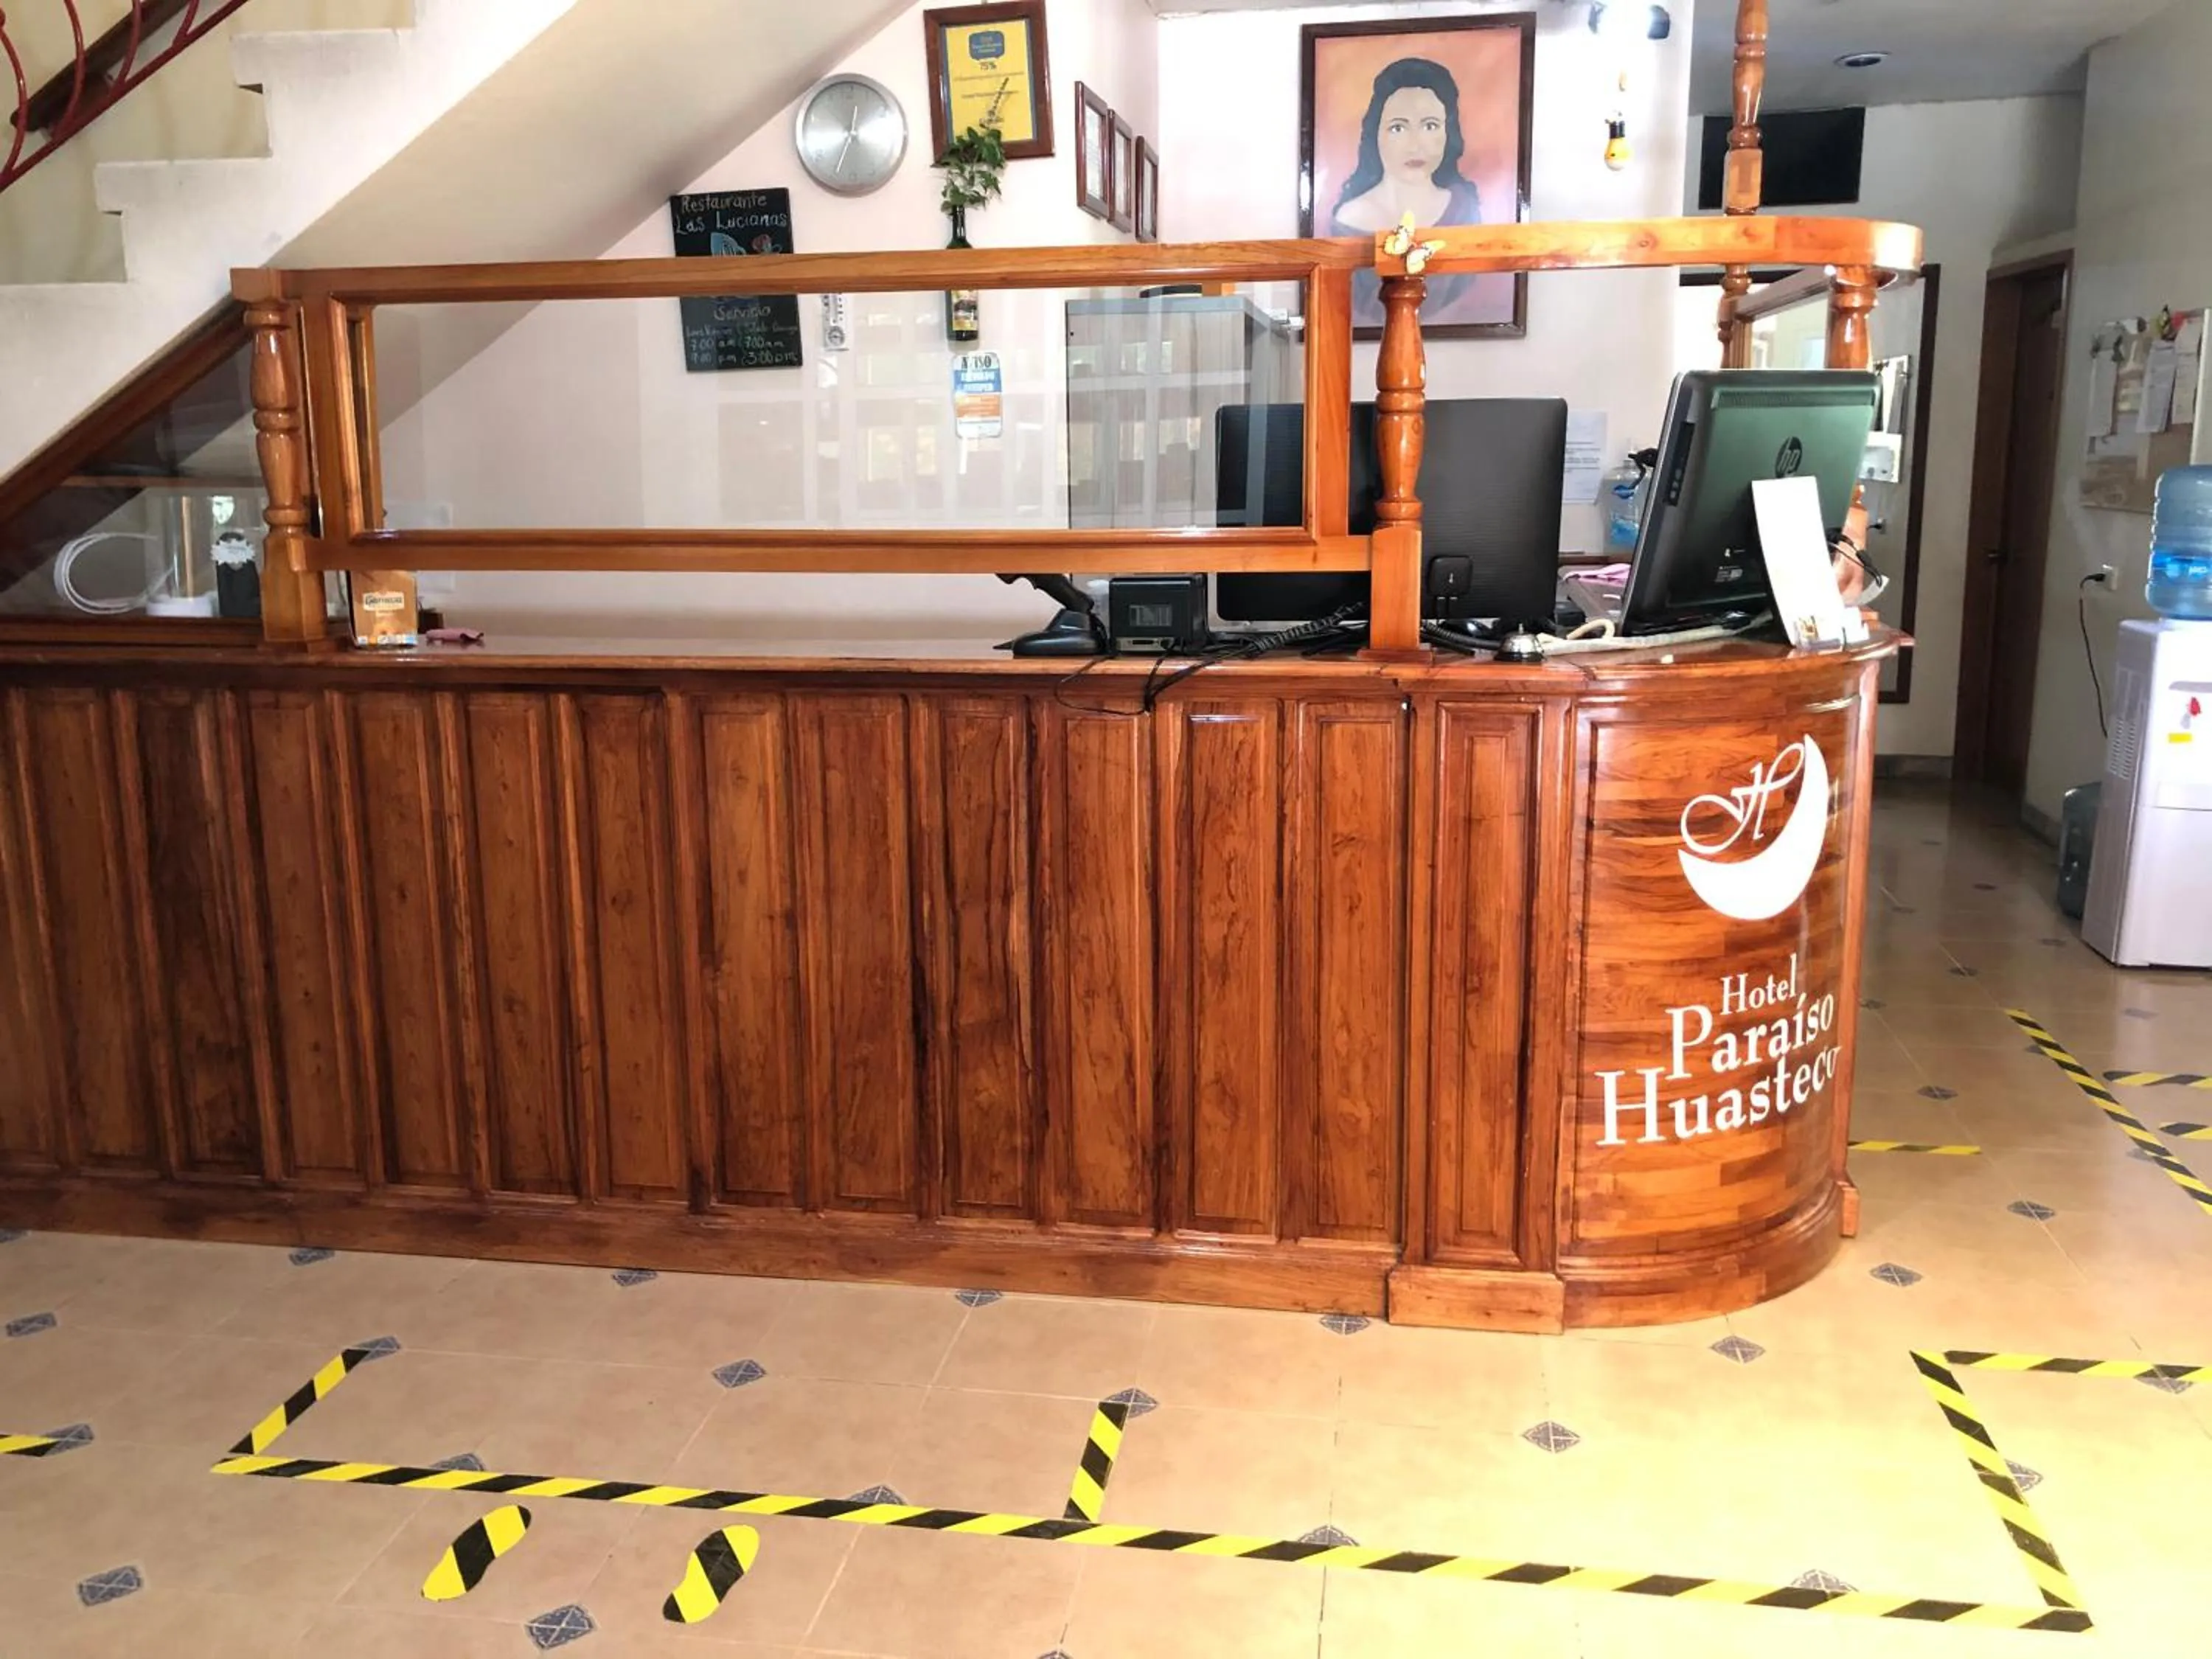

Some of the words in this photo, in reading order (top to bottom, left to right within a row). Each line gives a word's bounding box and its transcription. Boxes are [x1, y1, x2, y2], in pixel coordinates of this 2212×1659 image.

[674, 215, 705, 234] Las
[715, 210, 788, 229] Lucianas
[681, 194, 767, 214] Restaurante
[713, 305, 771, 321] Servicio
[1777, 437, 1801, 478] hp
[1719, 953, 1798, 1016] Hotel
[1664, 992, 1834, 1081] Paraíso
[1594, 1046, 1843, 1146] Huasteco
